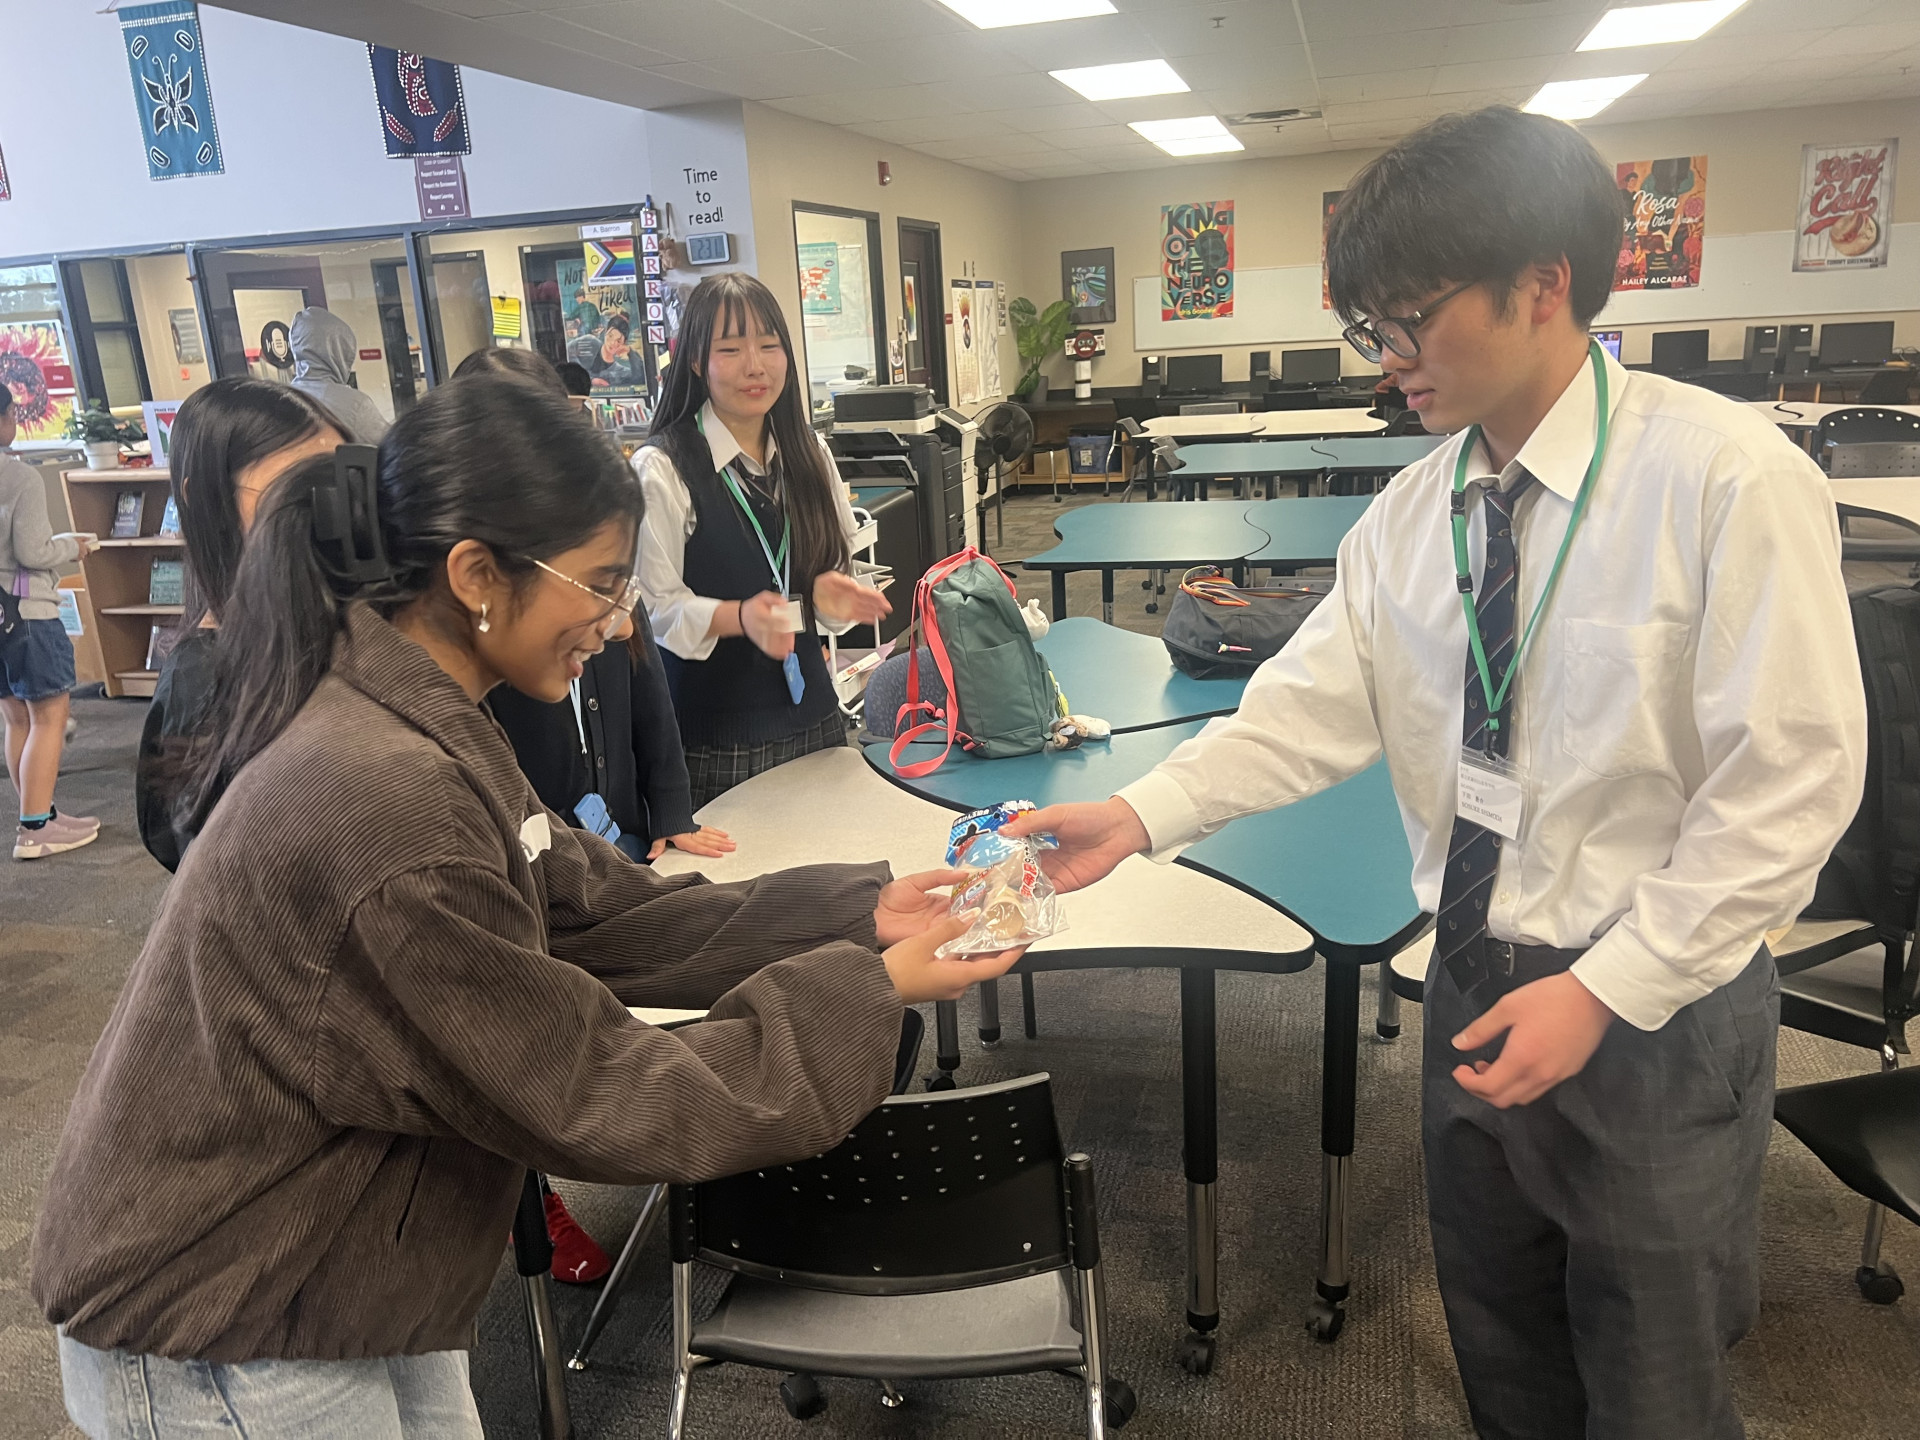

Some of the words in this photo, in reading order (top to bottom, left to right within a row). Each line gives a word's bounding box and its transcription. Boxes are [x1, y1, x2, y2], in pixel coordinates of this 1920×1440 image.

[683, 168, 718, 184] Time
[1814, 147, 1888, 192] Right
[695, 190, 711, 204] to
[1632, 190, 1680, 215] Rosa
[1810, 174, 1879, 218] Call
[688, 206, 724, 226] read!
[1167, 207, 1229, 239] KING
[1167, 237, 1196, 255] OF
[1167, 257, 1204, 274] THE
[644, 211, 663, 341] BARRON
[1167, 270, 1229, 291] NEURO
[1622, 277, 1649, 286] HAILEY
[1650, 275, 1688, 285] ALCARAZ
[599, 286, 634, 313] Liked
[1168, 288, 1227, 308] VERSE
